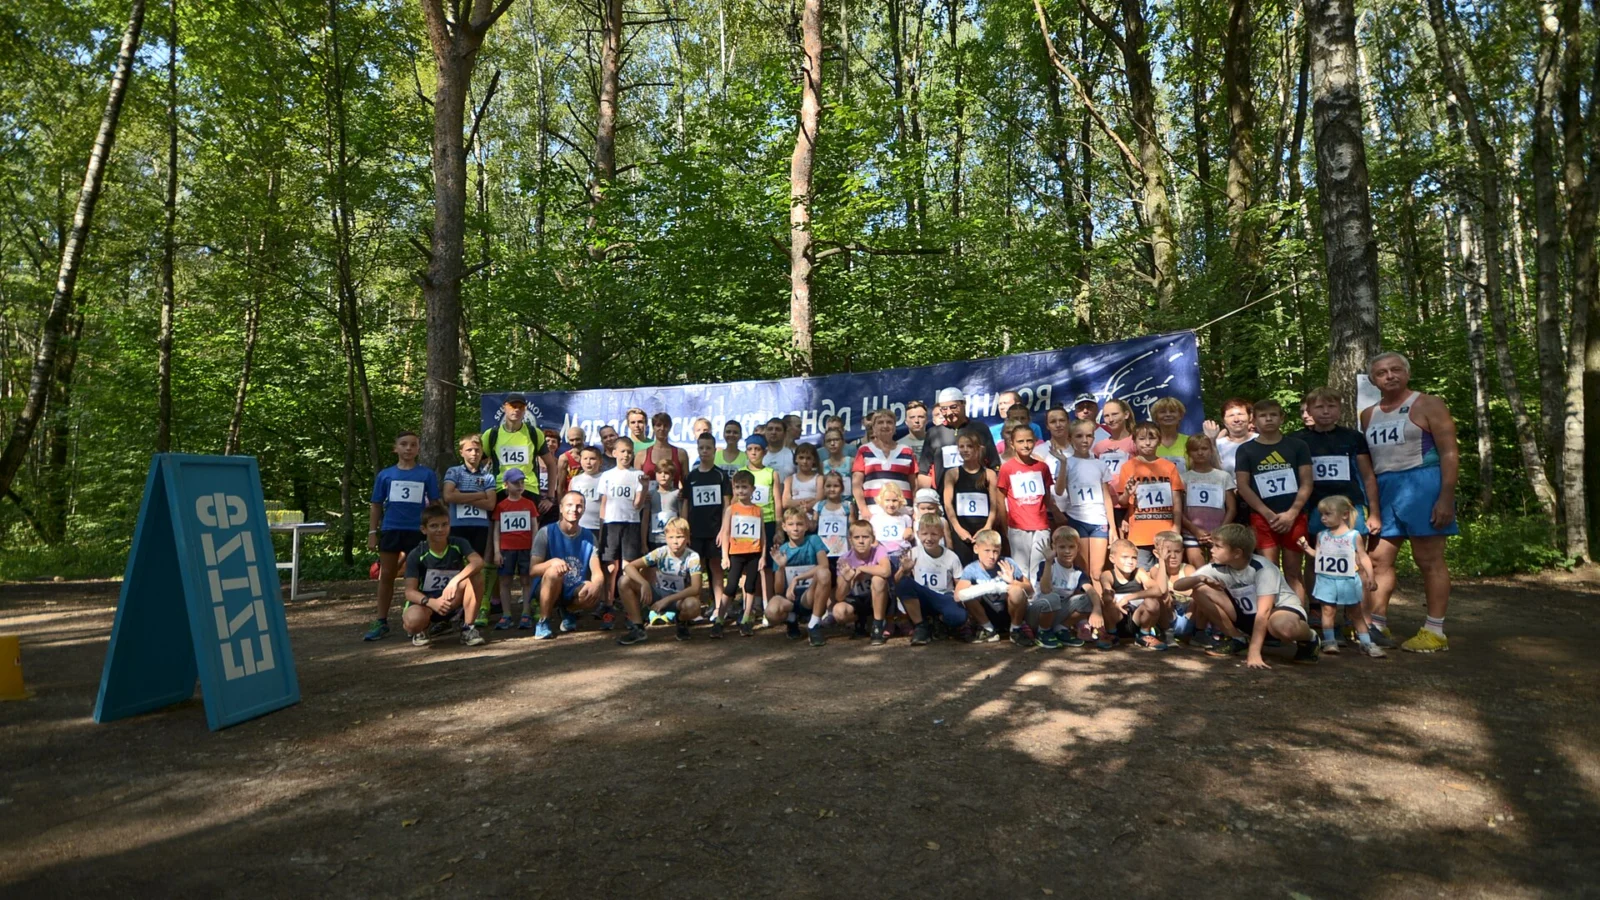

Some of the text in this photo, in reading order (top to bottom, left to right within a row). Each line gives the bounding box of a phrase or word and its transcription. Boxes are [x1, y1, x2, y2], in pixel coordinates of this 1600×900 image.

[1370, 427, 1399, 445] 114
[502, 451, 525, 463] 145
[1105, 459, 1119, 472] 27
[1257, 463, 1291, 471] adidas
[1316, 463, 1339, 477] 95
[1020, 480, 1037, 494] 10
[1266, 477, 1287, 493] 37
[401, 487, 410, 499] 3
[579, 487, 595, 499] 41
[610, 486, 631, 498] 108
[696, 491, 716, 503] 131
[1078, 488, 1095, 501] 11
[1145, 491, 1164, 505] 14
[1199, 490, 1209, 503] 9
[464, 505, 480, 516] 26
[968, 500, 977, 513] 8
[504, 517, 527, 530] 140
[735, 523, 756, 535] 121
[824, 522, 839, 533] 76
[882, 525, 899, 538] 53
[1318, 555, 1349, 574] 120
[195, 492, 275, 681] ФИНИШ
[431, 575, 449, 590] 23
[661, 579, 677, 591] 24
[922, 573, 939, 587] 16
